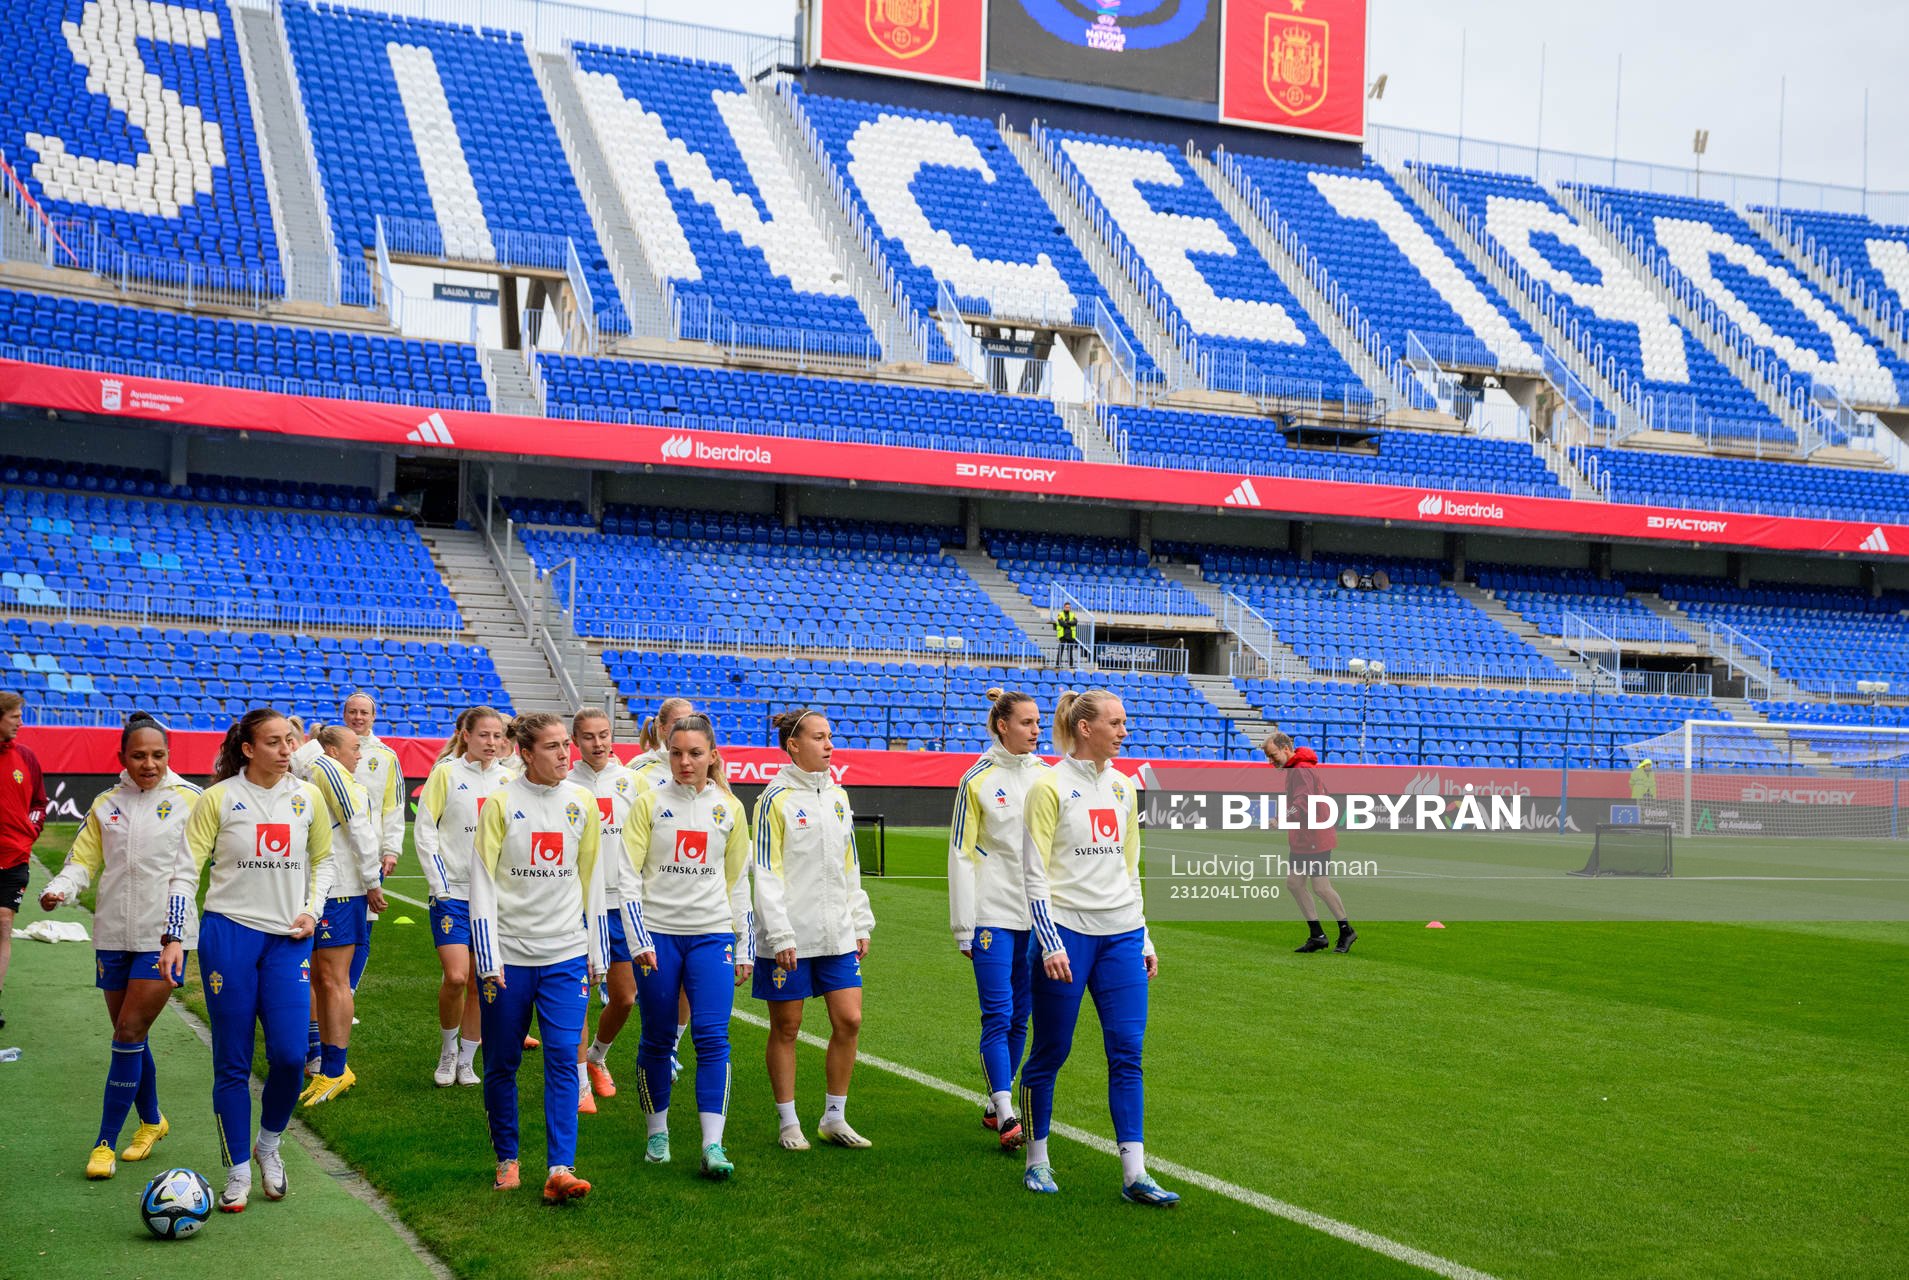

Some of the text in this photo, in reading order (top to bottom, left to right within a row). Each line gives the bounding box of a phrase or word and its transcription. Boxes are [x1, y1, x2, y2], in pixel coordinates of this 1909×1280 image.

[1086, 28, 1126, 45] NATIONS
[1088, 38, 1124, 52] LEAGUE
[23, 0, 1307, 346] SINCE
[441, 286, 492, 300] SALIDA EXIT
[987, 343, 1029, 354] SALIDA EXIT
[130, 389, 184, 404] Ayuntamiento
[695, 441, 771, 464] Iberdrola
[979, 465, 1056, 482] FACTORY
[1444, 500, 1504, 519] Iberdrola
[1665, 517, 1727, 533] FACTORY
[726, 761, 849, 782] FACY
[45, 780, 85, 820] ía
[1767, 789, 1856, 805] FACTORY
[1137, 796, 1208, 828] alucía
[1644, 808, 1668, 817] Unión
[1719, 810, 1739, 819] Junta
[1728, 820, 1763, 830] Andalucía
[1074, 846, 1114, 856] SVENSKA
[237, 860, 302, 870] SVENSKA SPEL
[511, 867, 556, 878] SVENSKA
[700, 867, 717, 875] SPEL
